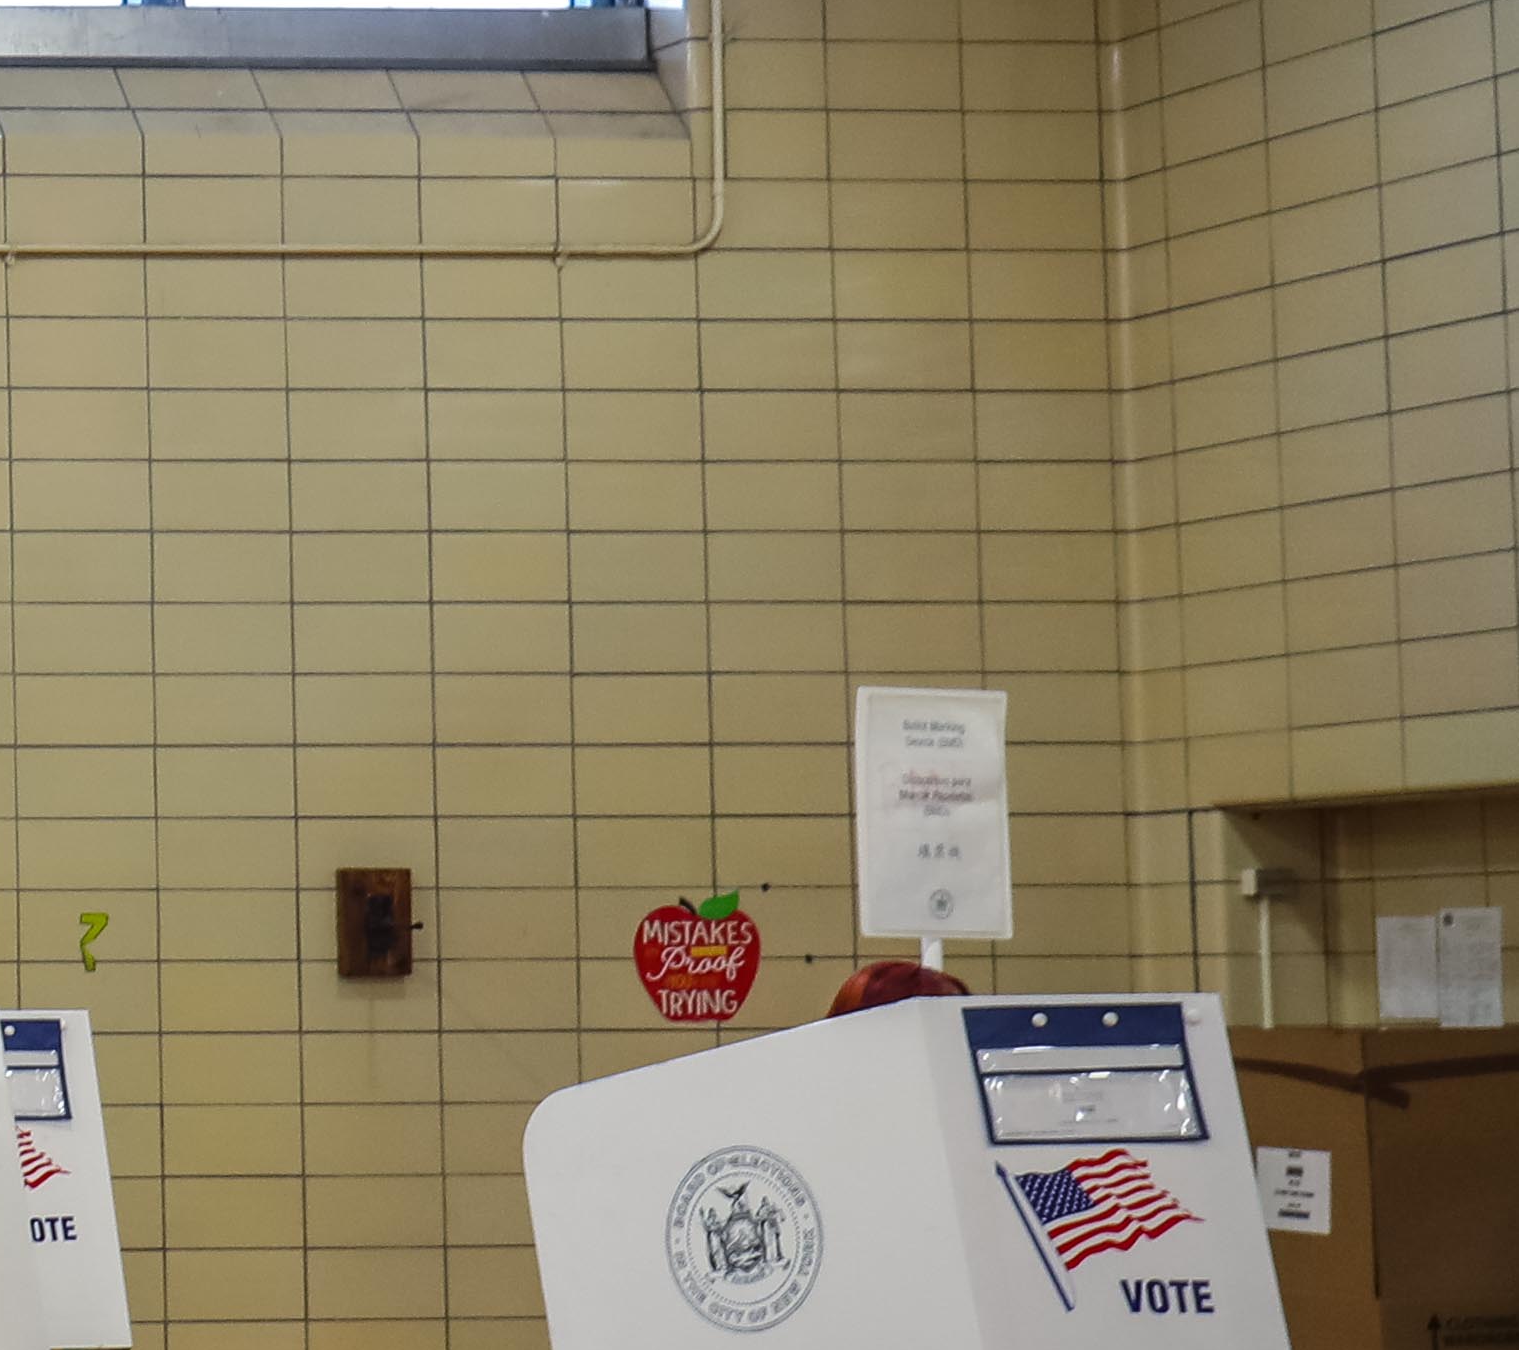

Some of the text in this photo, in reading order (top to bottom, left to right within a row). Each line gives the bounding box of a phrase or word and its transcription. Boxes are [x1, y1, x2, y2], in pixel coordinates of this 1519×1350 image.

[643, 919, 753, 945] MISTAKES
[646, 945, 745, 981] Proof
[657, 989, 738, 1017] TRYING
[728, 1154, 805, 1207] ELECTIONS
[29, 1216, 77, 1242] OTE
[1120, 1279, 1215, 1314] VOTE
[708, 1301, 744, 1324] CITY
[748, 1306, 767, 1323] OF
